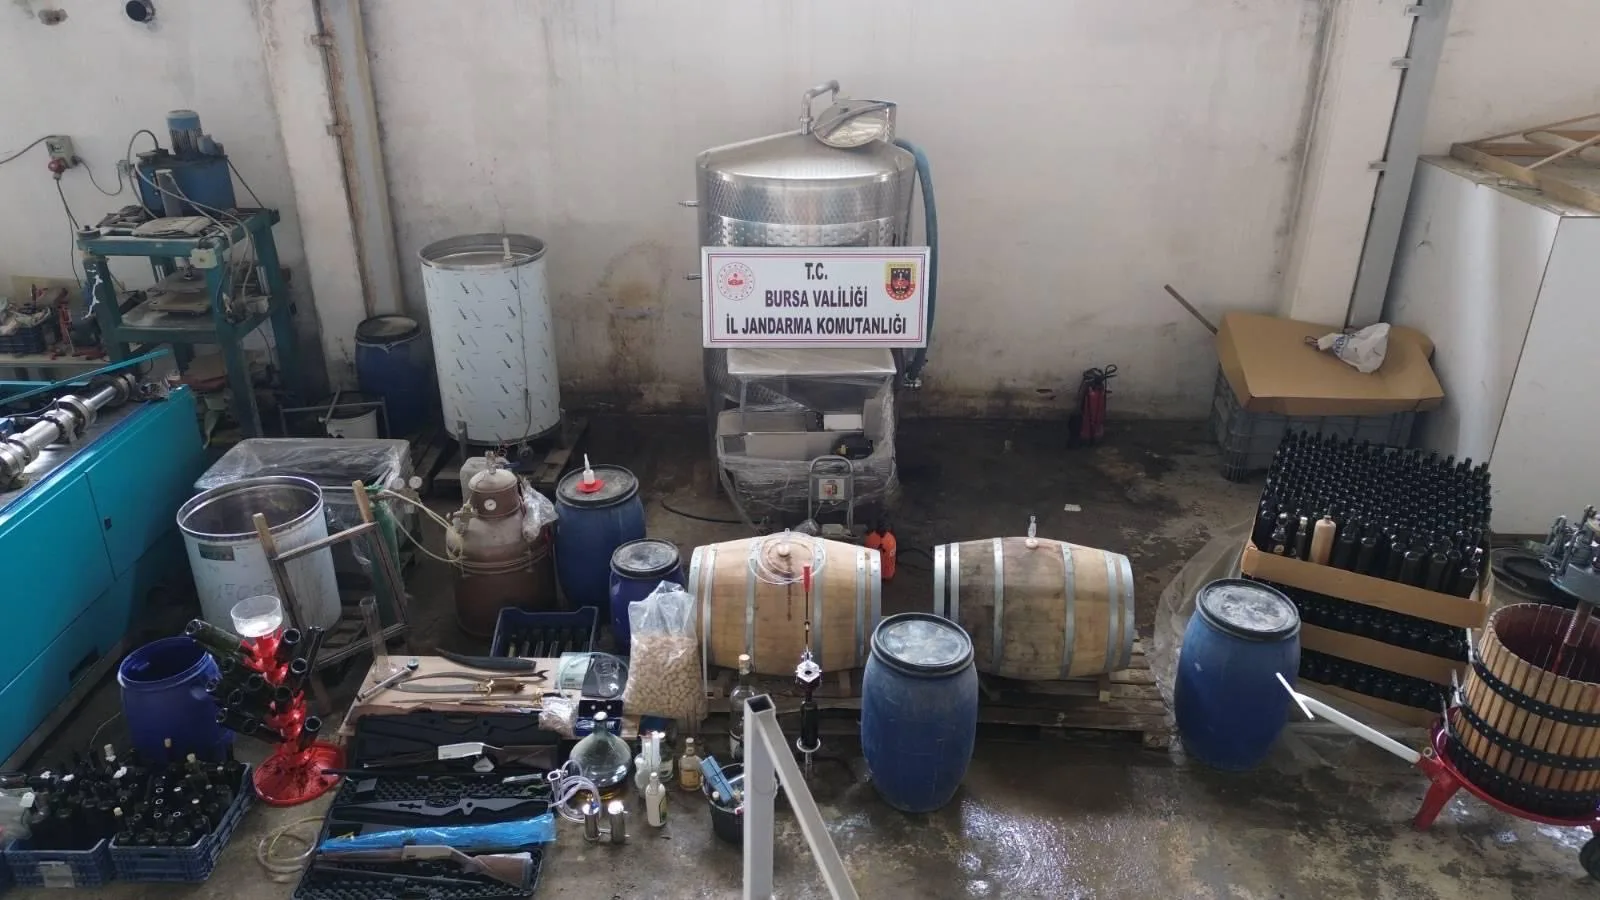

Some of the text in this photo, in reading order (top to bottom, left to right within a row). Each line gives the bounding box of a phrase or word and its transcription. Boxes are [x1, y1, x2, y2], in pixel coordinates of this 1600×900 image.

[805, 262, 828, 281] T.C.
[765, 286, 868, 308] BURSA VALİLİĞİ
[726, 313, 907, 335] İL JANDARMA KOMUTANLIĞI
